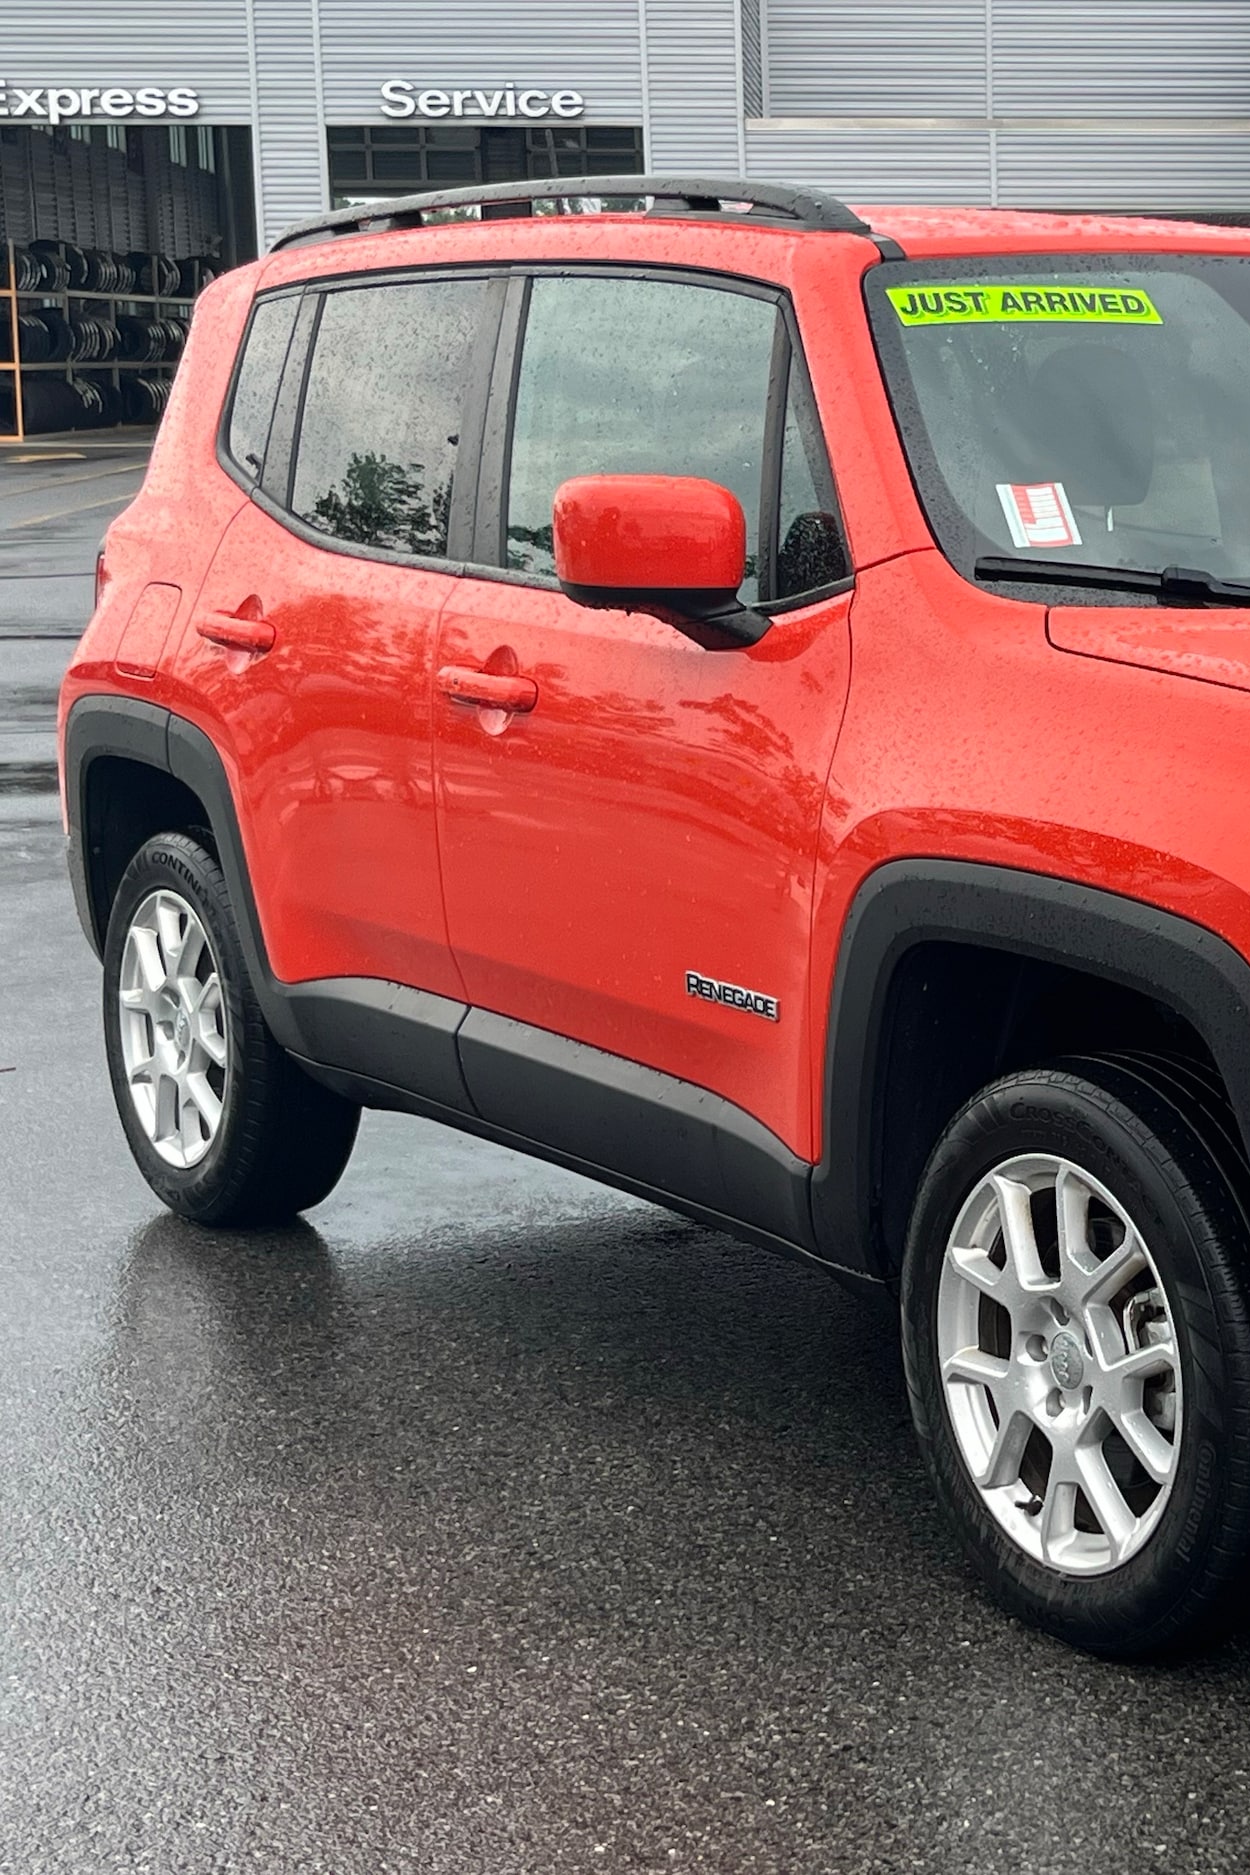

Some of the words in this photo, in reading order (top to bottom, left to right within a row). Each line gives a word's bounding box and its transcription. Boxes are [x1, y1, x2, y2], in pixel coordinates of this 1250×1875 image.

[380, 80, 585, 118] Service
[900, 291, 984, 316] JUST
[1001, 292, 1147, 315] ARRIVED
[685, 970, 780, 1022] RENEGADE
